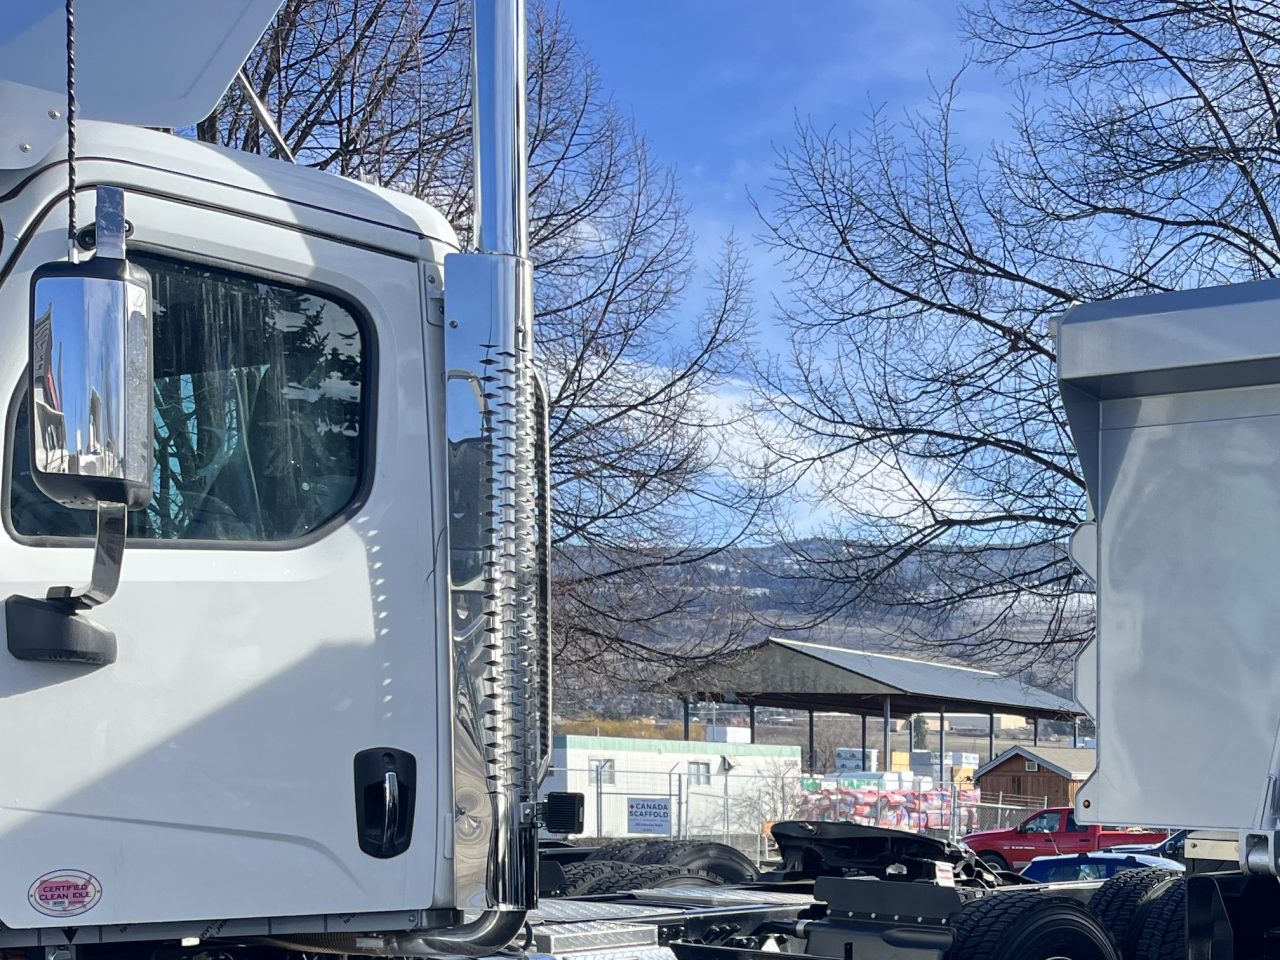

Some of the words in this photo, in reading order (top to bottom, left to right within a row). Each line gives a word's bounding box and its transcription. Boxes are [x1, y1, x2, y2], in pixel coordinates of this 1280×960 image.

[635, 803, 669, 811] CANADA
[629, 810, 669, 818] SCAFFOLD
[43, 884, 88, 893] CERTIFIED
[39, 893, 69, 901] CLEAN
[72, 891, 92, 899] IDLE
